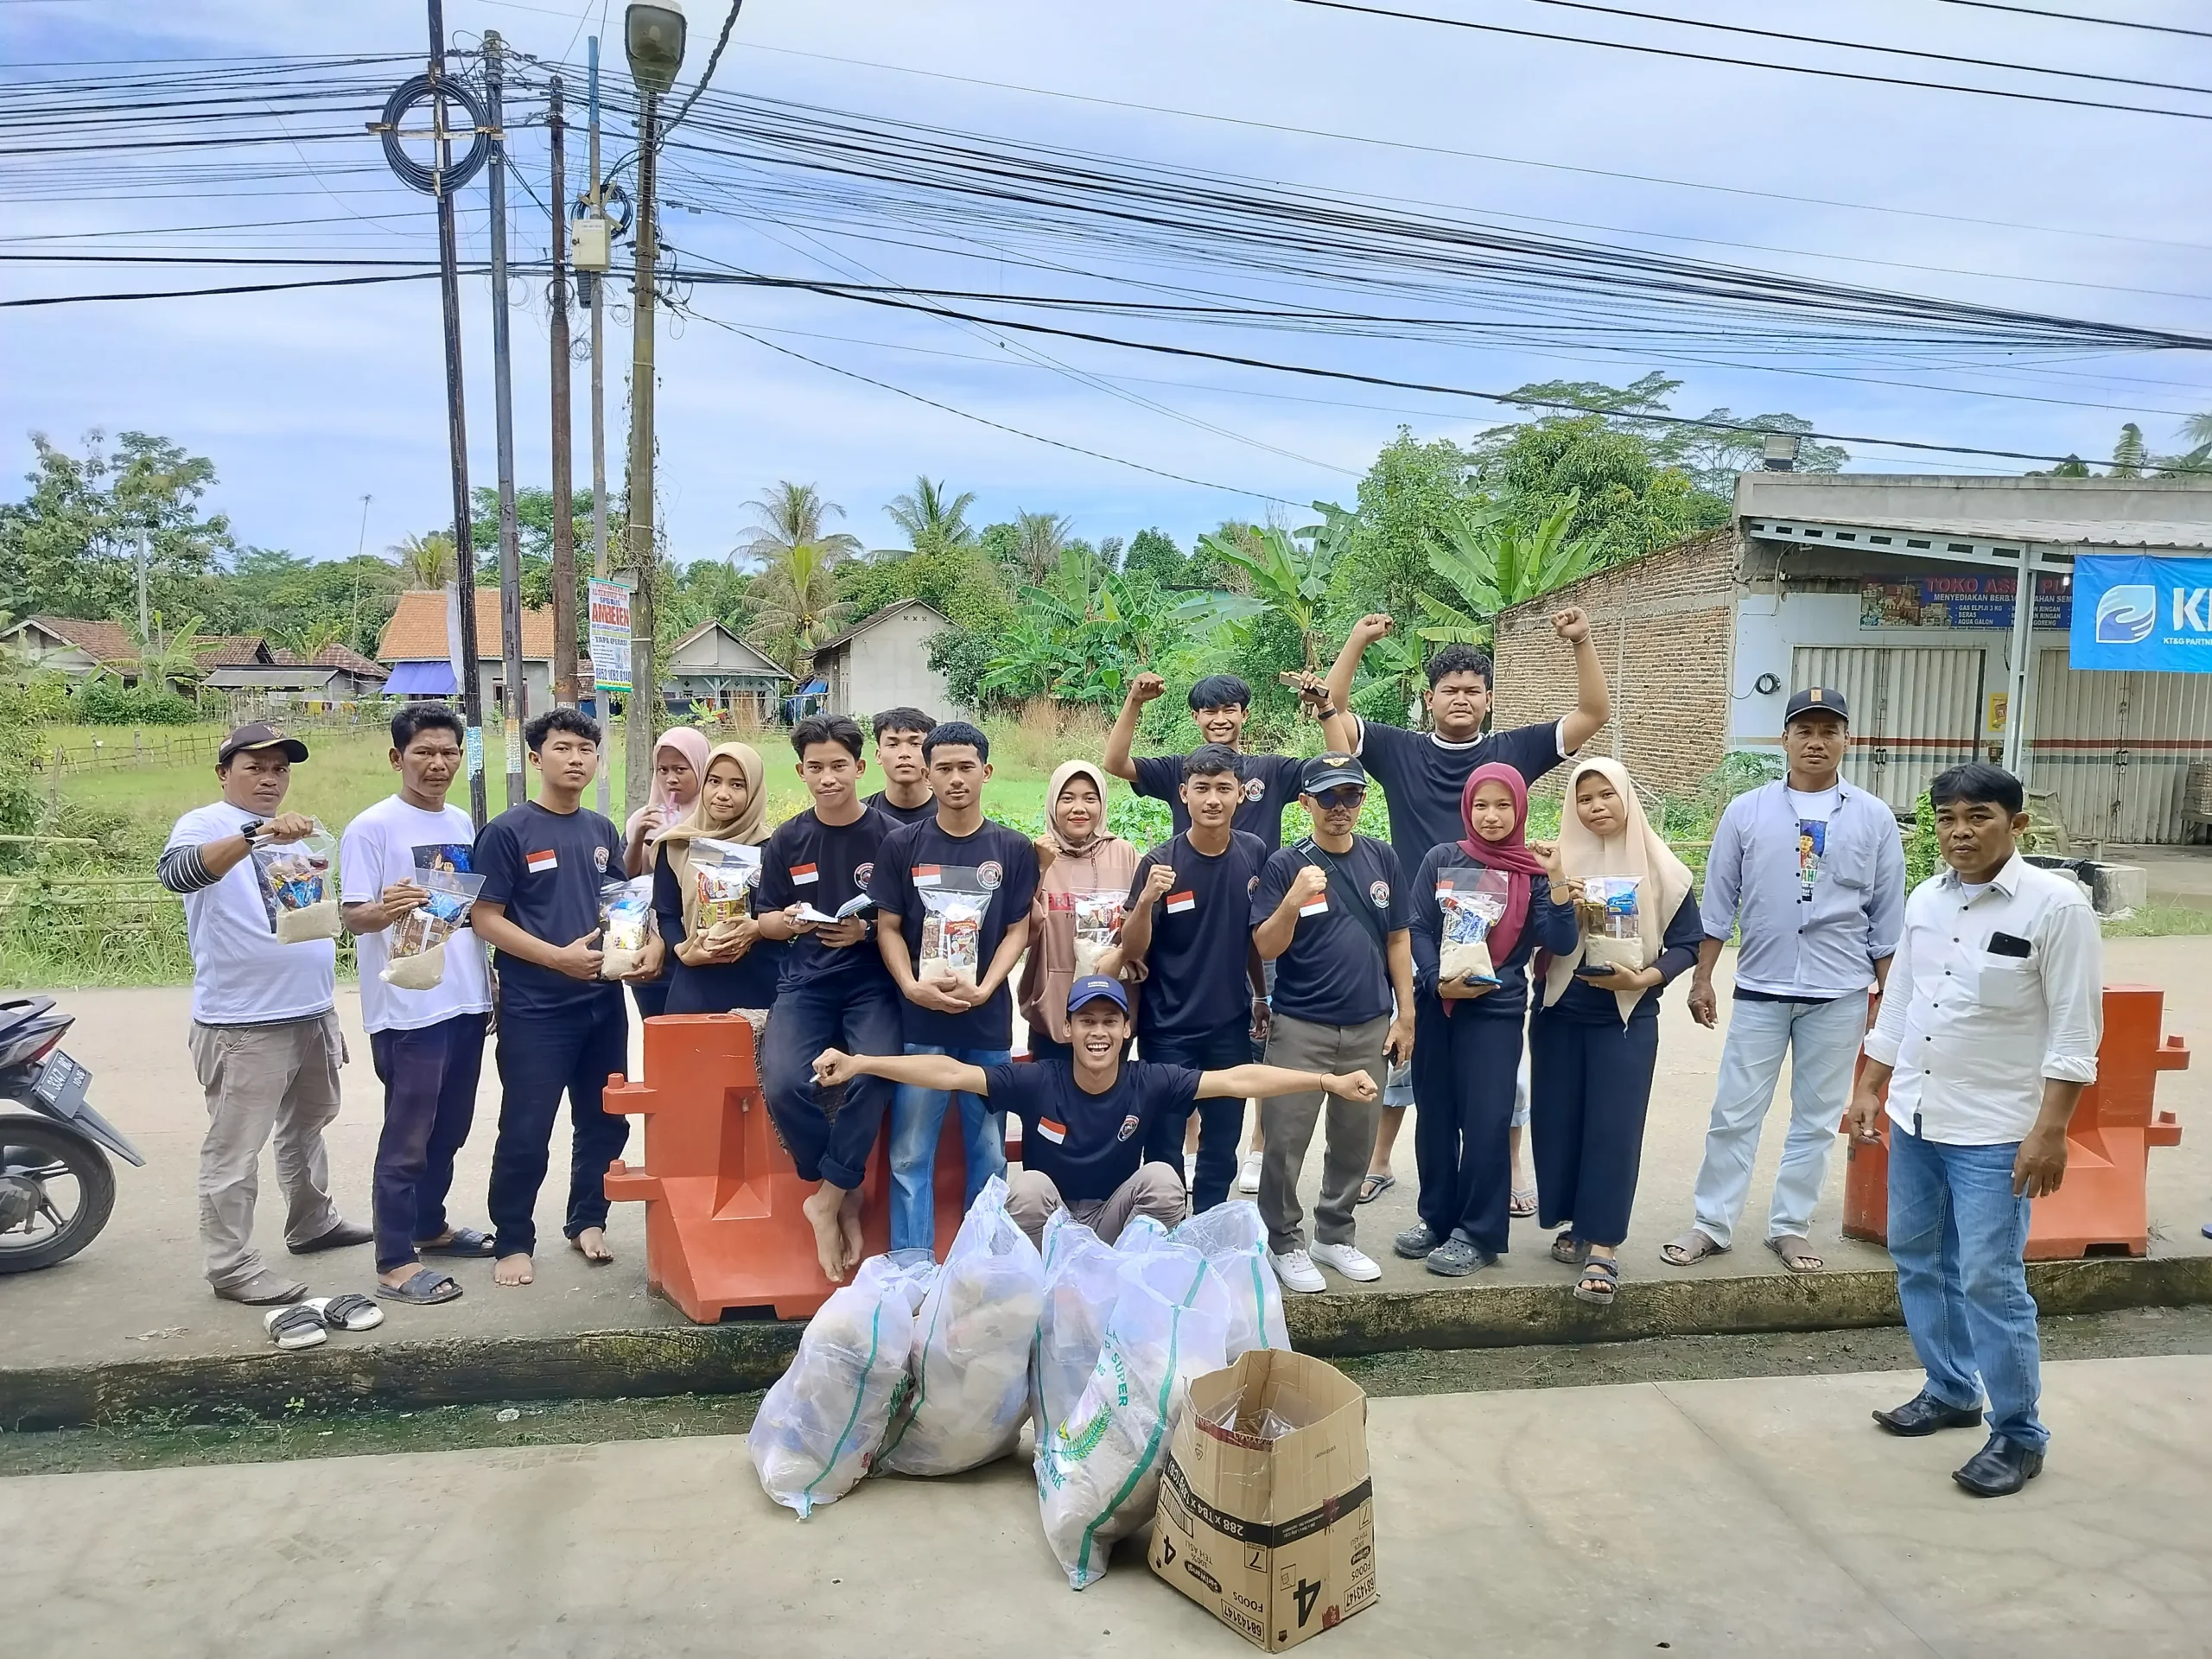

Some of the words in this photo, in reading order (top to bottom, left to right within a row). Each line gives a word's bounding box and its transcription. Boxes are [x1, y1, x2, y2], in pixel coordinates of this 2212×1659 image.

[1925, 577, 1979, 594] TOKO
[1934, 594, 1988, 602] MENYEDIAKAN
[592, 602, 630, 627] AMBEIEN
[47, 1067, 67, 1090] 3347
[41, 1089, 57, 1102] A
[1111, 1352, 1128, 1407] SUPER
[1167, 1460, 1180, 1484] (CS)
[1191, 1498, 1197, 1509] x
[1198, 1503, 1214, 1523] TB4
[1215, 1515, 1221, 1525] x
[1362, 1506, 1370, 1526] 7
[1223, 1520, 1244, 1536] 288
[1164, 1535, 1177, 1566] 4
[1185, 1540, 1198, 1554] ASLI
[1191, 1553, 1208, 1569] 100%
[1199, 1551, 1213, 1565] TEH
[1249, 1552, 1262, 1569] 7
[1351, 1560, 1371, 1581] FOODS
[1346, 1577, 1375, 1607] 68143147
[1232, 1592, 1263, 1613] FOODS
[1294, 1578, 1321, 1629] 4
[1224, 1605, 1262, 1637] 68143147
